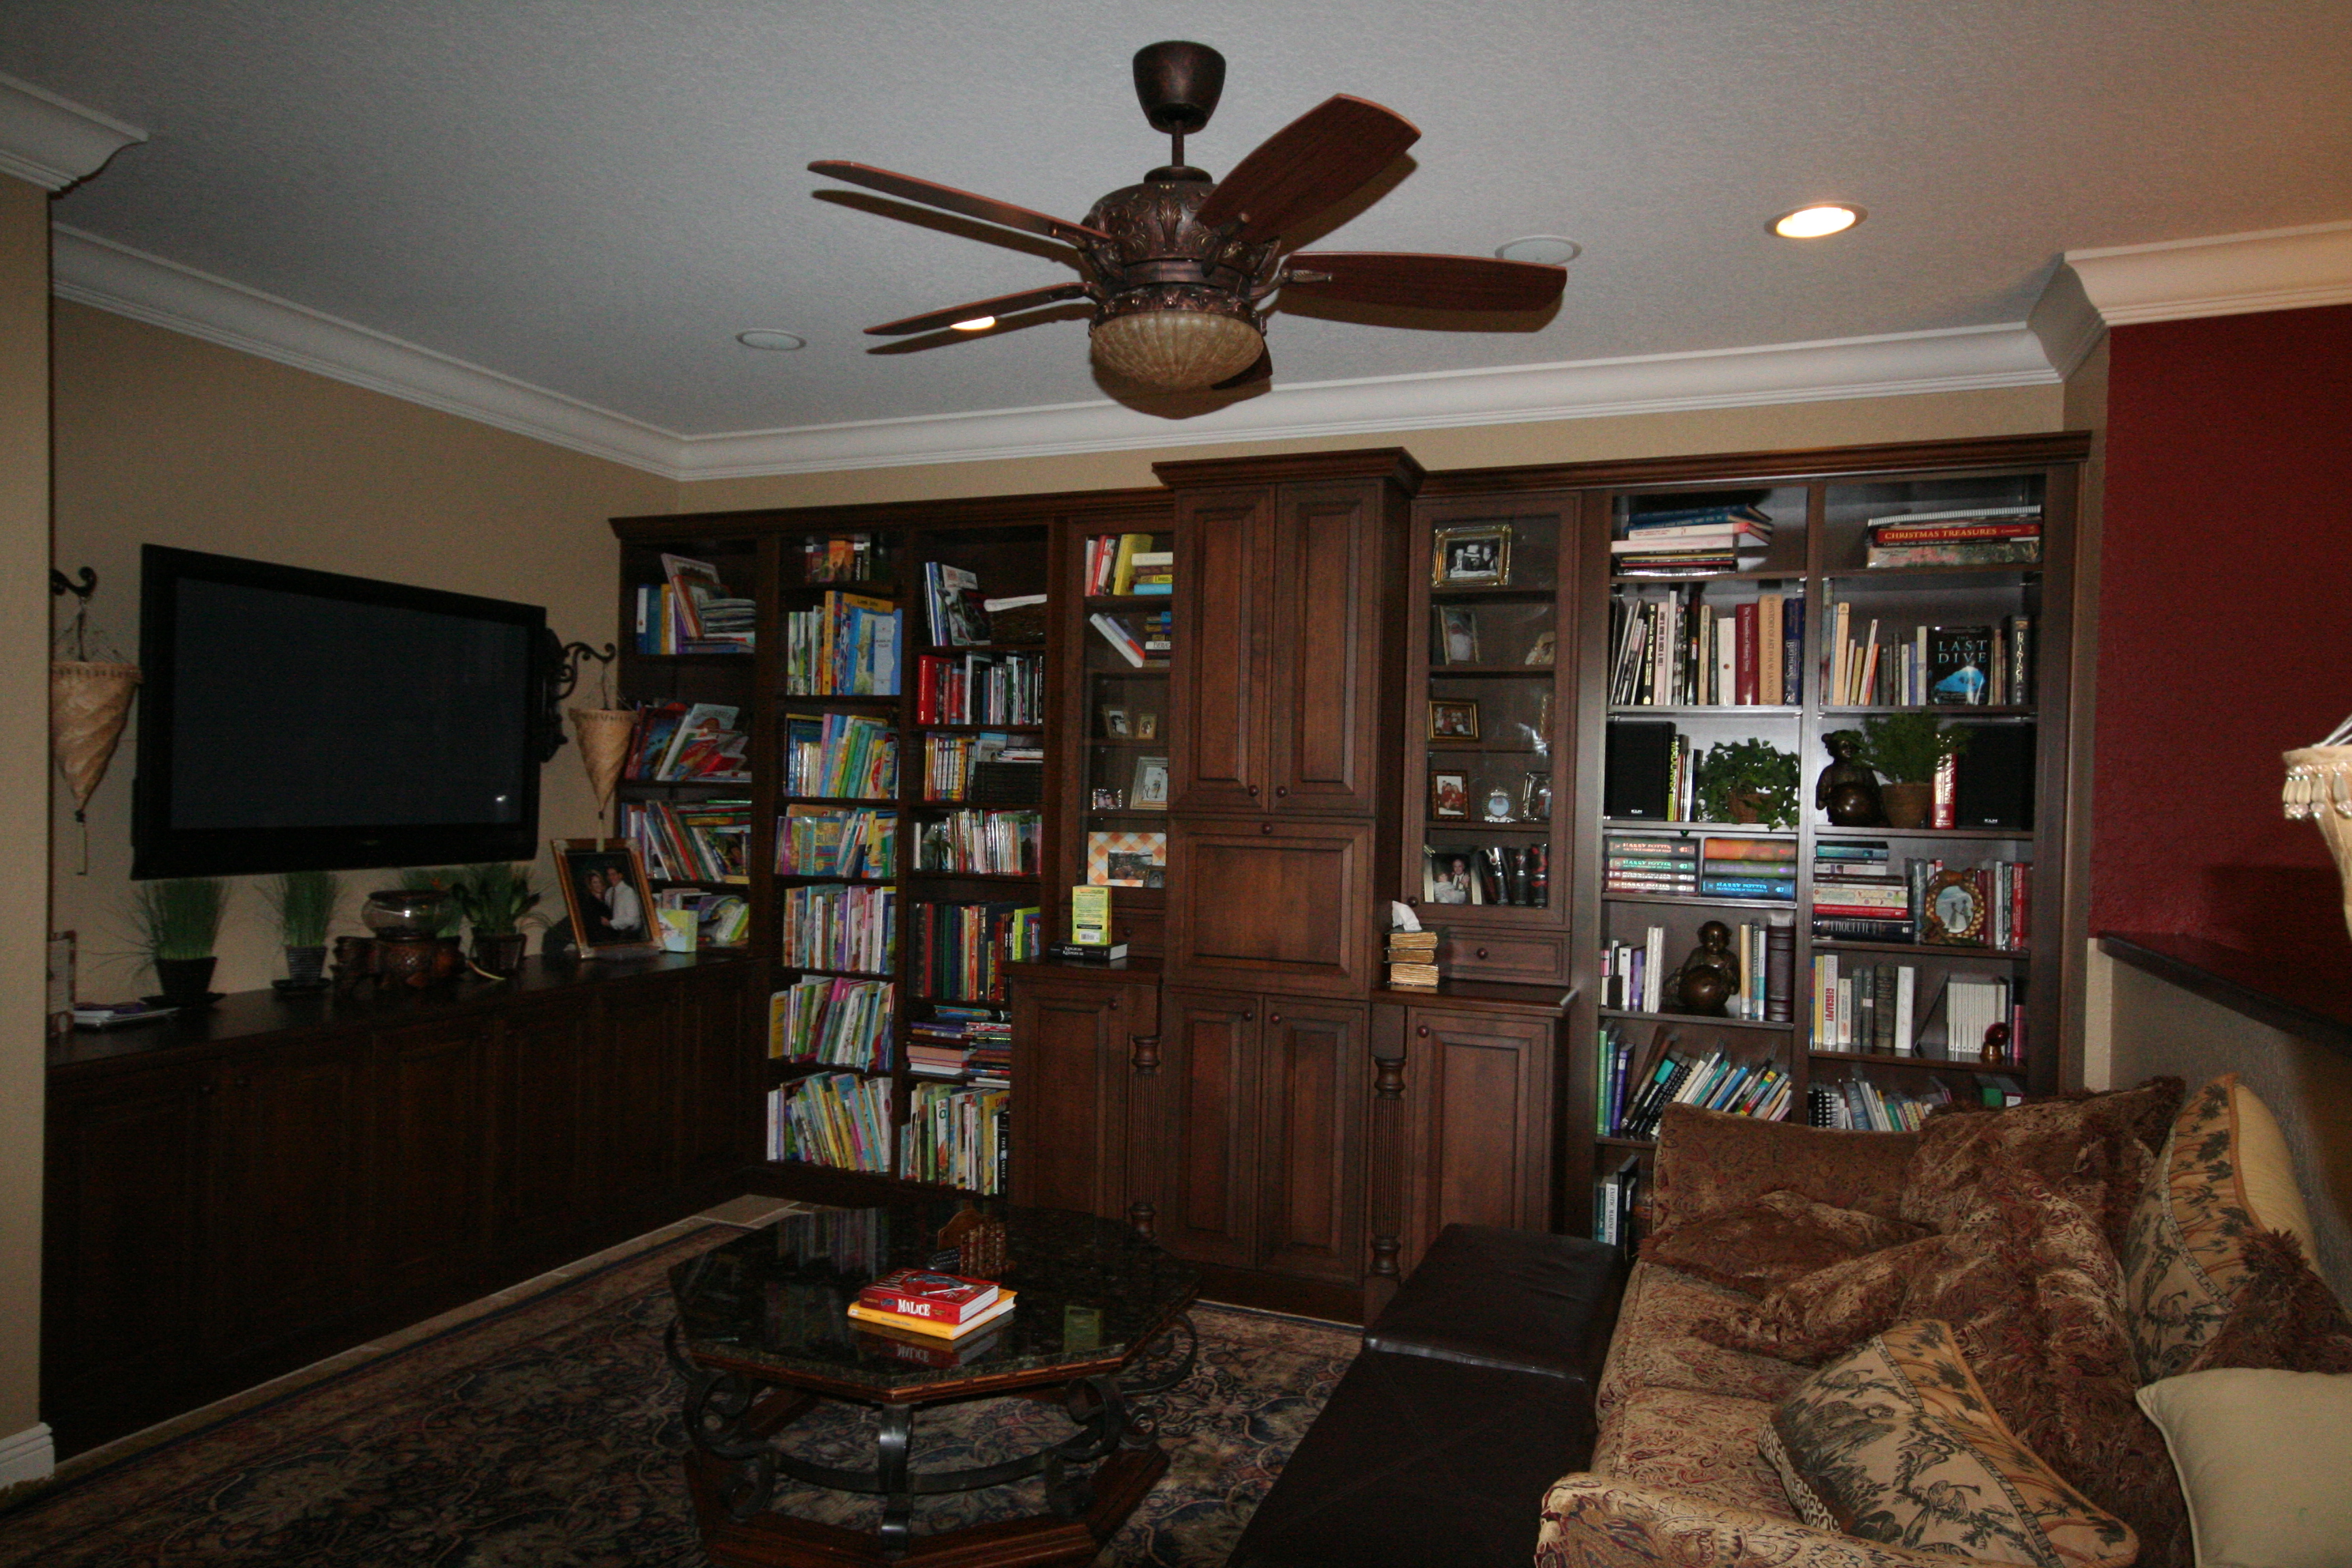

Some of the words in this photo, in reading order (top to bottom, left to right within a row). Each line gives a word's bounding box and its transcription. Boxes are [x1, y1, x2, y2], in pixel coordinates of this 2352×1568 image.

[1884, 530, 1940, 540] CHRISTMAS
[1943, 528, 1997, 537] TREASURES
[1938, 640, 1988, 651] LAST
[1938, 652, 1987, 664] DIVE
[1831, 921, 1869, 932] ETIQUETTE
[1825, 987, 1835, 1022] GEOGRAPHY
[896, 1298, 931, 1317] MALICE
